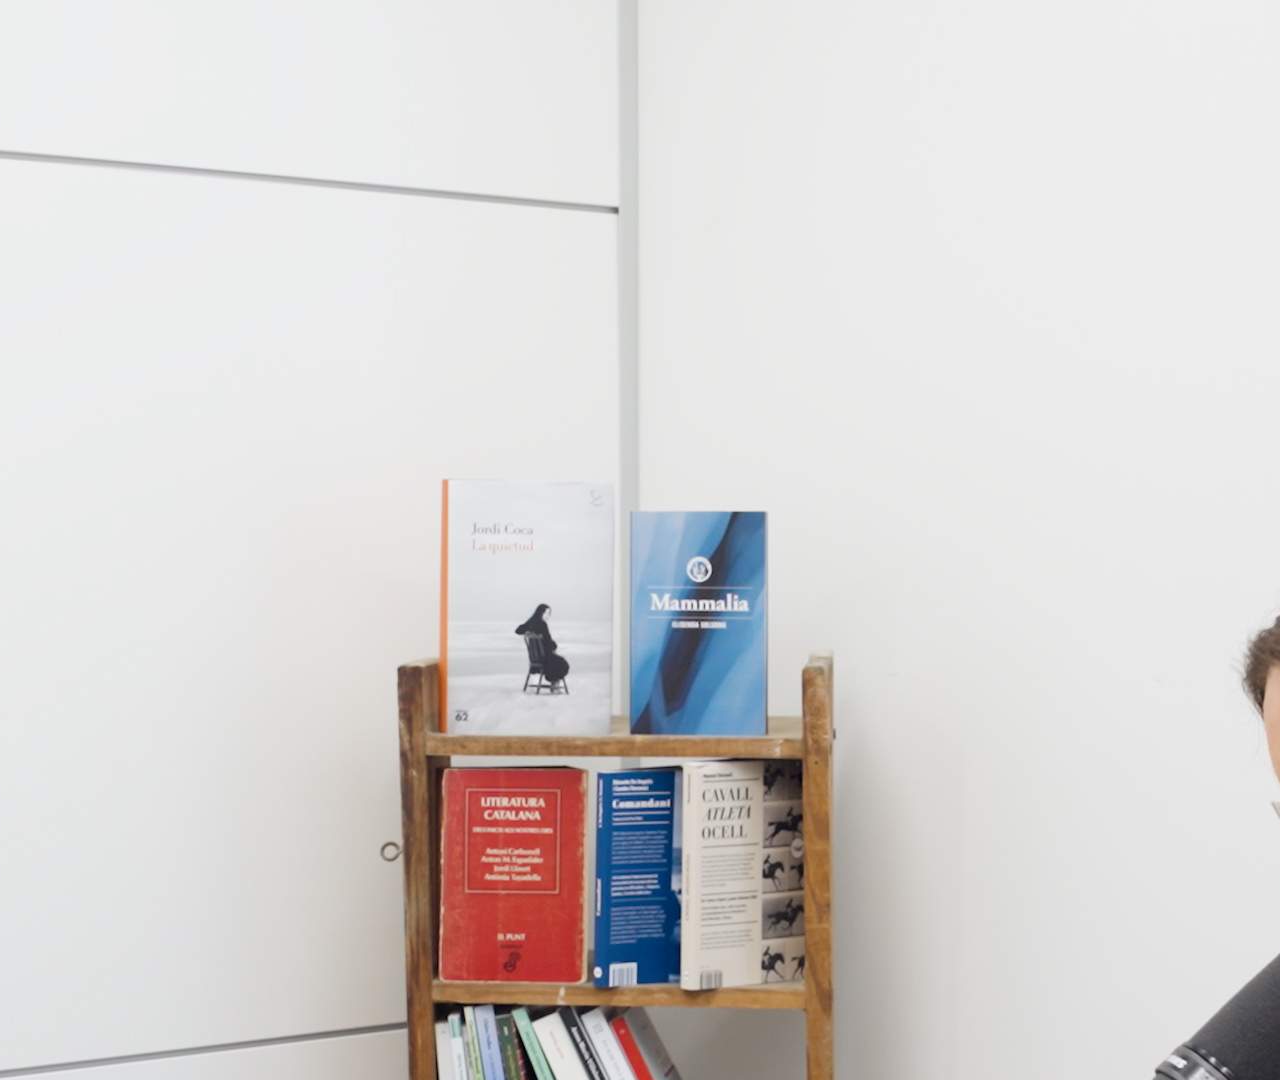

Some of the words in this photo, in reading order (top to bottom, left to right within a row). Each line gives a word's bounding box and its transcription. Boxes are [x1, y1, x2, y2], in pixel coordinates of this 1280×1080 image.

[503, 521, 535, 536] Coca
[650, 592, 750, 612] Mammalia
[480, 796, 546, 808] LITERATURA
[702, 786, 754, 803] CAVALL
[611, 798, 672, 809] Comandant
[483, 809, 542, 821] CATALANA
[704, 805, 752, 821] ATLETA
[701, 824, 749, 841] OCELL
